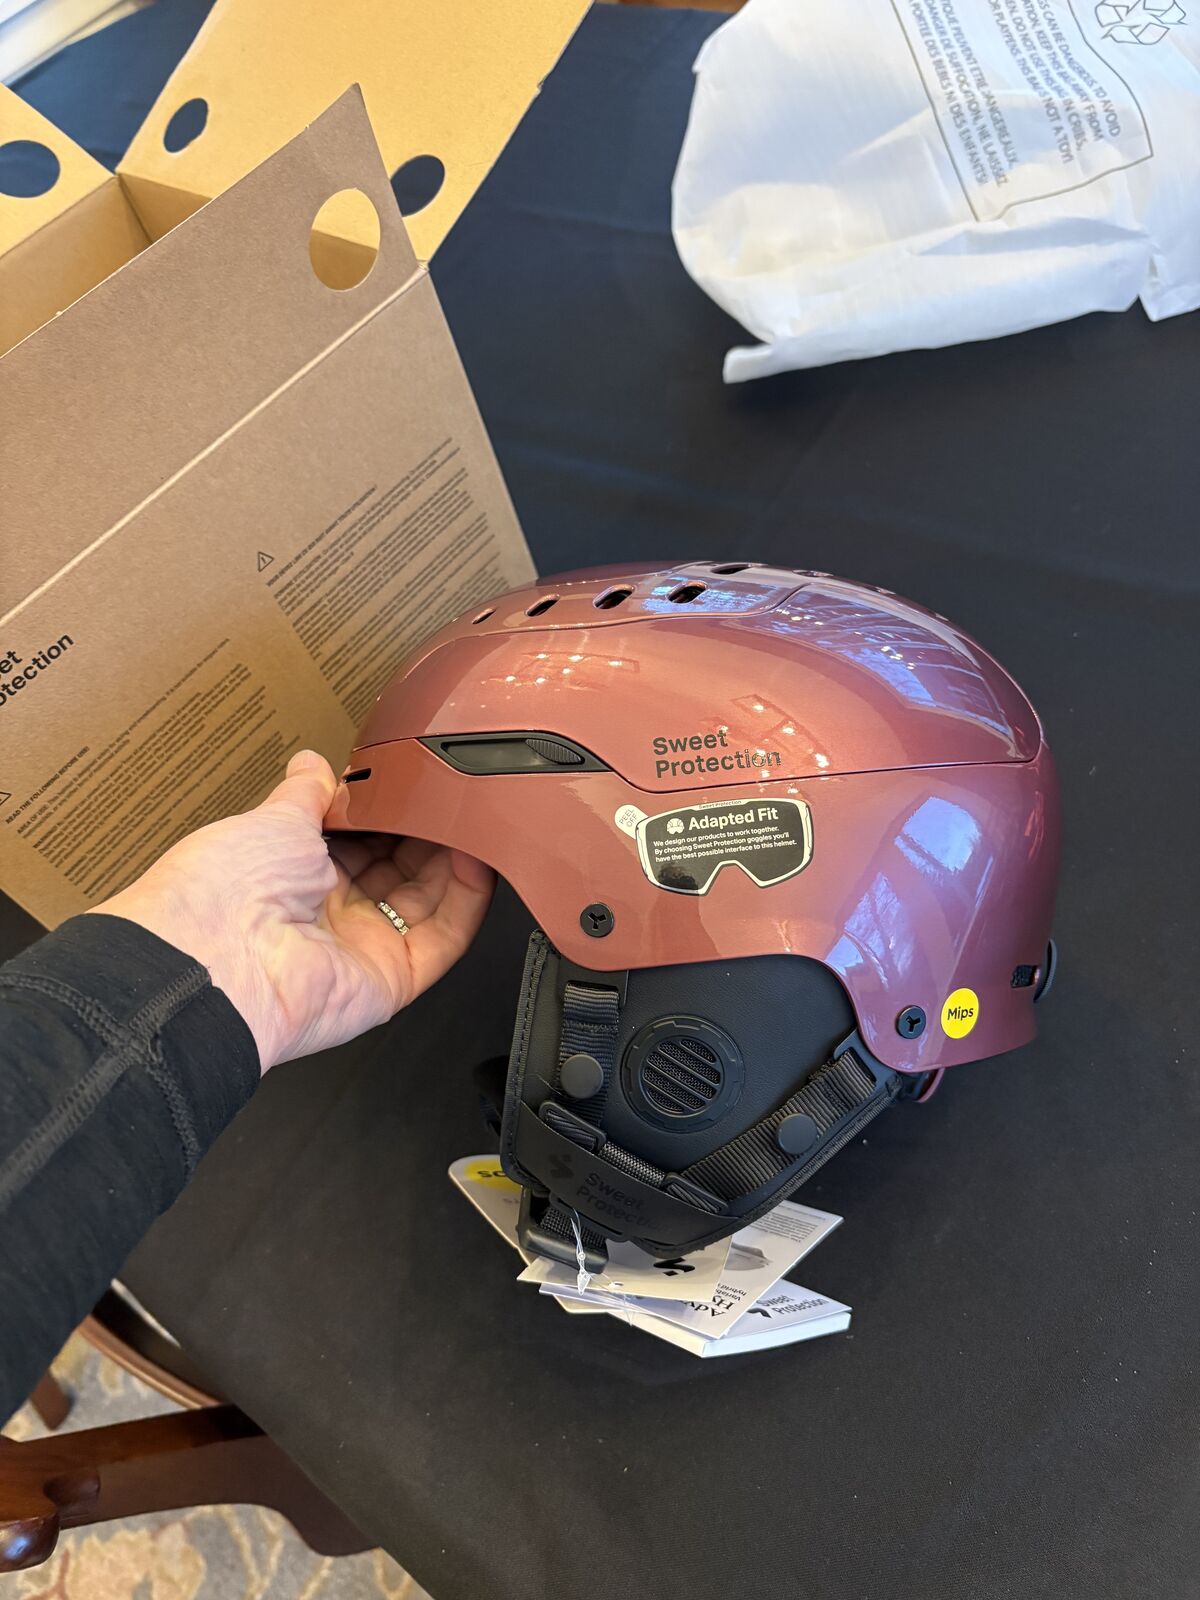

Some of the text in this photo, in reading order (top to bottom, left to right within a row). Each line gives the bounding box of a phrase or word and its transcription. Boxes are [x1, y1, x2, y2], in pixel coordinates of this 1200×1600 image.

[1012, 16, 1026, 32] DO
[1043, 10, 1059, 31] CAN
[941, 0, 959, 25] IQUE
[951, 26, 978, 65] PEUVENT
[970, 66, 989, 91] ETRE
[1019, 33, 1037, 52] NOT
[1052, 31, 1066, 44] BE
[1016, 58, 1034, 76] THIS
[1029, 52, 1046, 69] USE
[925, 39, 940, 58] DES
[933, 58, 953, 90] BEBES
[950, 103, 968, 129] DES
[1035, 30, 1053, 51] KEEP
[1047, 51, 1064, 71] THIS
[1084, 104, 1105, 142] FROM
[1040, 68, 1056, 86] THIS
[941, 38, 955, 50] DE
[976, 124, 991, 143] NE
[1093, 86, 1107, 99] TO
[1042, 97, 1062, 122] NOT
[1062, 98, 1076, 112] IN
[1099, 99, 1121, 137] AVOID
[1052, 126, 1064, 136] A
[1067, 111, 1088, 152] CRIBS,
[1057, 133, 1074, 163] TOY!
[0, 651, 22, 674] et
[652, 729, 729, 755] Sweet
[655, 748, 782, 778] Protection
[20, 801, 32, 811] THE
[619, 808, 634, 825] PEEL
[626, 813, 638, 828] OFF
[688, 807, 779, 831] Adapted Fit
[653, 840, 664, 848] We
[664, 838, 686, 847] design
[698, 832, 726, 843] products
[734, 828, 750, 836] work
[750, 825, 780, 835] together.
[654, 848, 663, 856] By
[663, 843, 693, 854] choosing
[693, 841, 713, 850] Sweet
[713, 837, 747, 847] Protection
[747, 834, 773, 844] goggles
[655, 855, 671, 863] have
[671, 853, 682, 861] the
[682, 851, 698, 860] best
[698, 847, 724, 857] possible
[724, 844, 753, 853] interface
[774, 839, 798, 848] helmet.
[947, 1006, 974, 1021] Mips
[584, 1172, 644, 1211] Sweet
[715, 1288, 742, 1302] Variab
[686, 1299, 727, 1319] Adv
[772, 1297, 829, 1315] Protection
